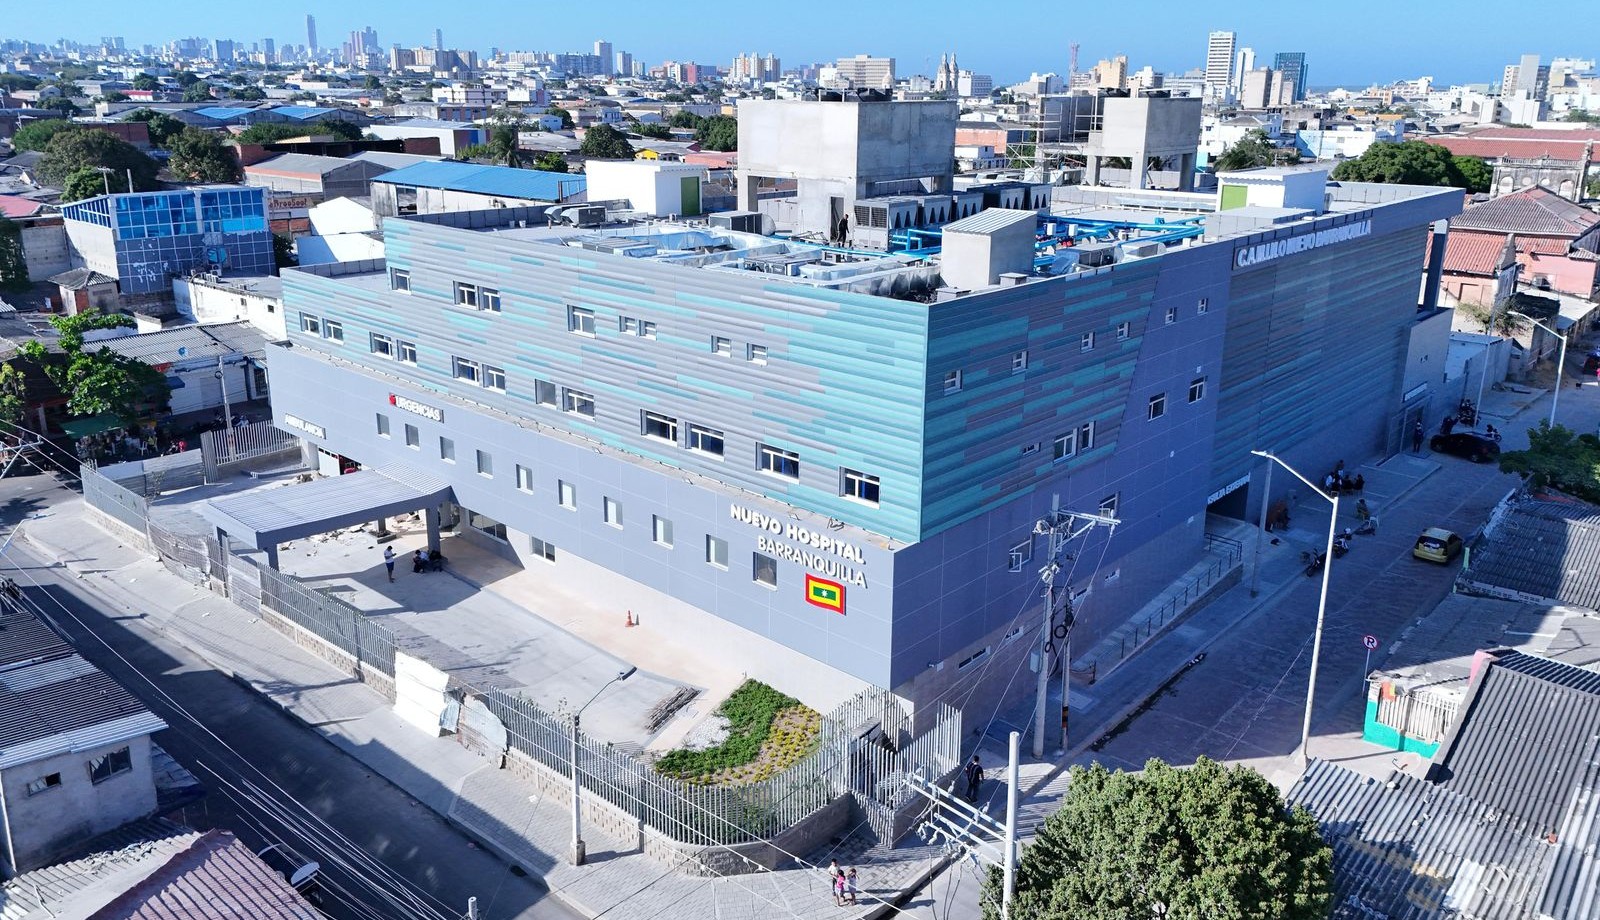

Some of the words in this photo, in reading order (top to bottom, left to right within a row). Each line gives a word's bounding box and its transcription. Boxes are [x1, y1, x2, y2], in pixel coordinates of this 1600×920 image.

[395, 395, 441, 421] URGENCIAS
[730, 503, 782, 535] NUEVO
[787, 523, 866, 564] HOSPITAL
[758, 535, 867, 588] BARRANQUILLA
